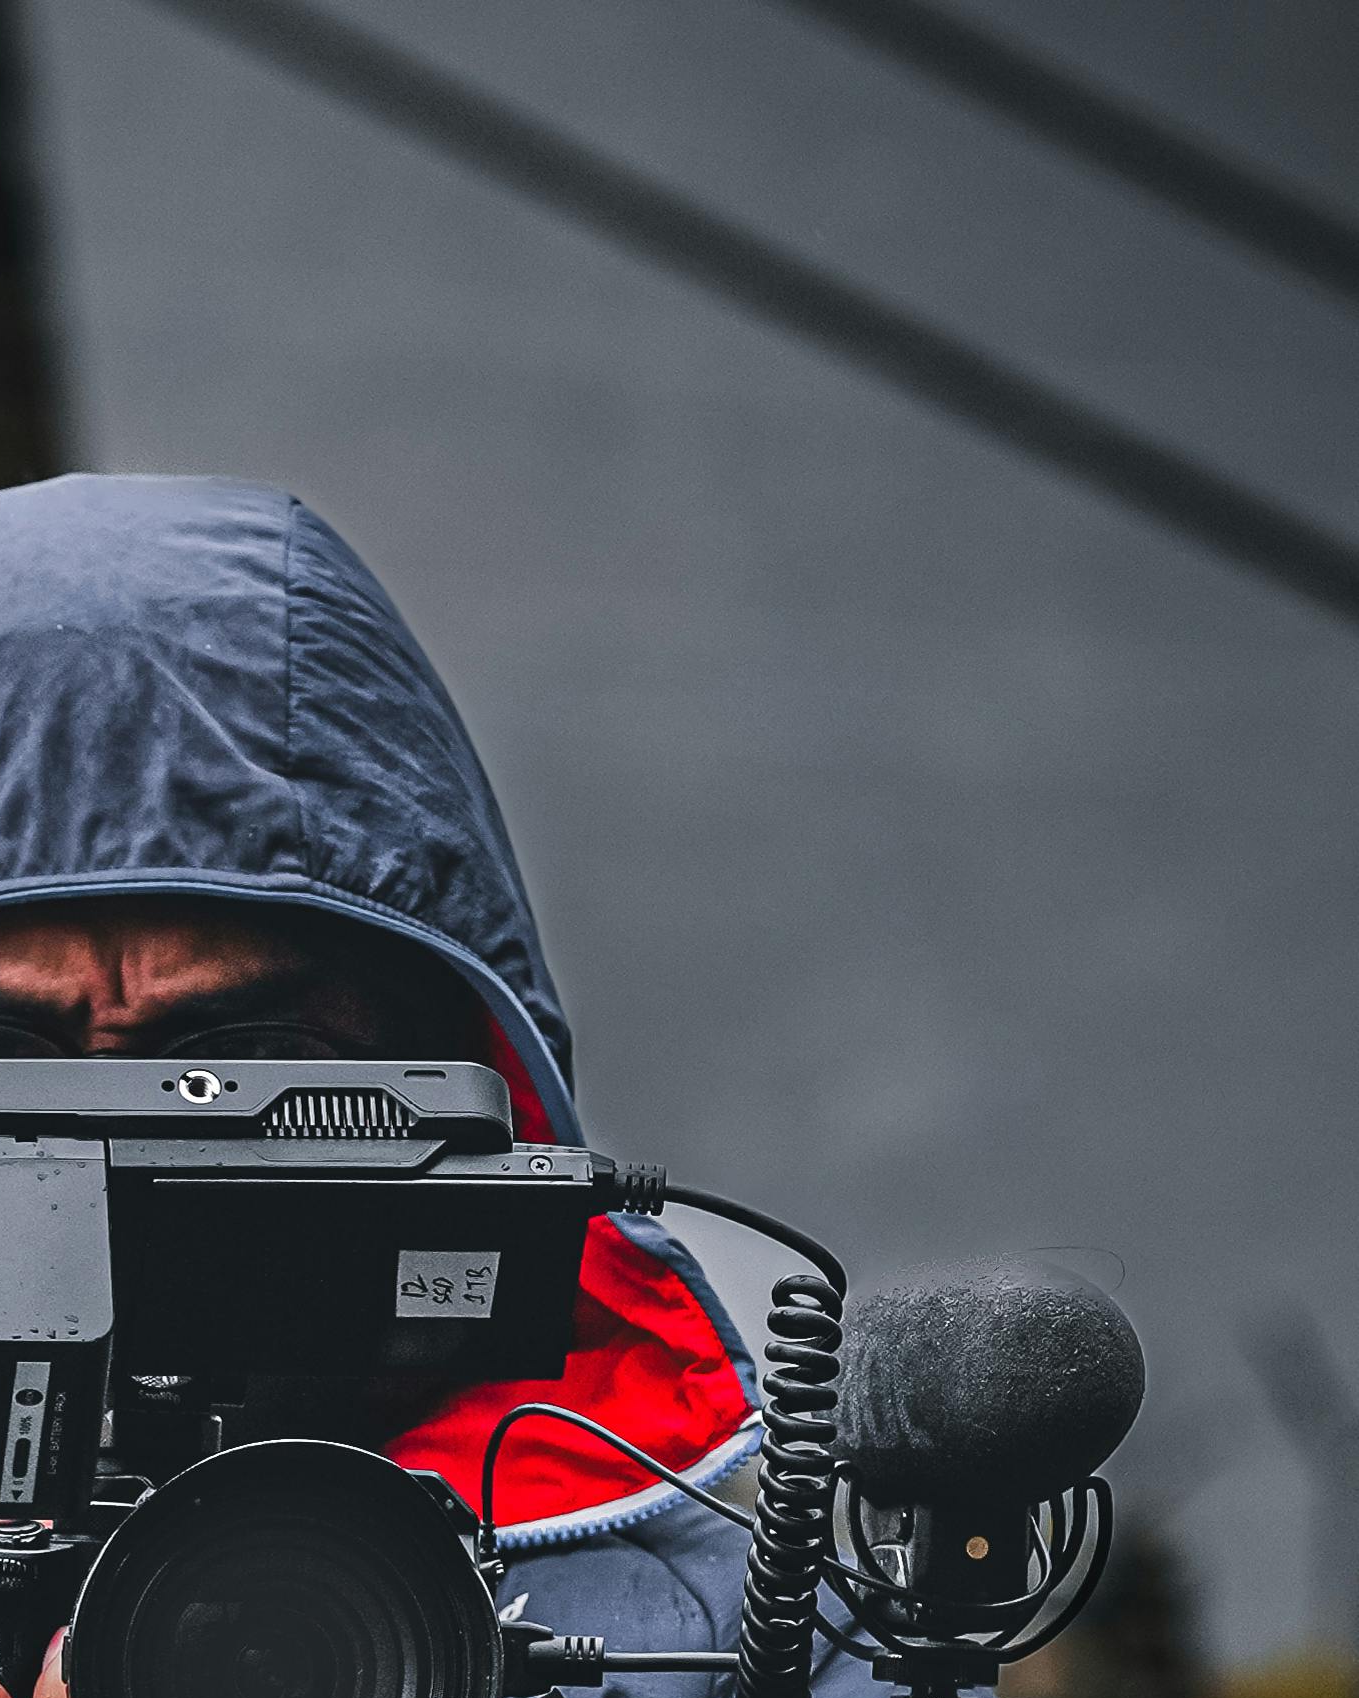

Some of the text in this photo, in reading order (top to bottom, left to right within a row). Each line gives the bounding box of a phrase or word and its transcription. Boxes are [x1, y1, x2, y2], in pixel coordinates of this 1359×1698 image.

[400, 1273, 428, 1298] 12
[432, 1277, 455, 1304] SSD
[53, 1391, 67, 1412] PACK
[19, 1415, 33, 1435] 100%
[49, 1416, 63, 1451] BATTERY
